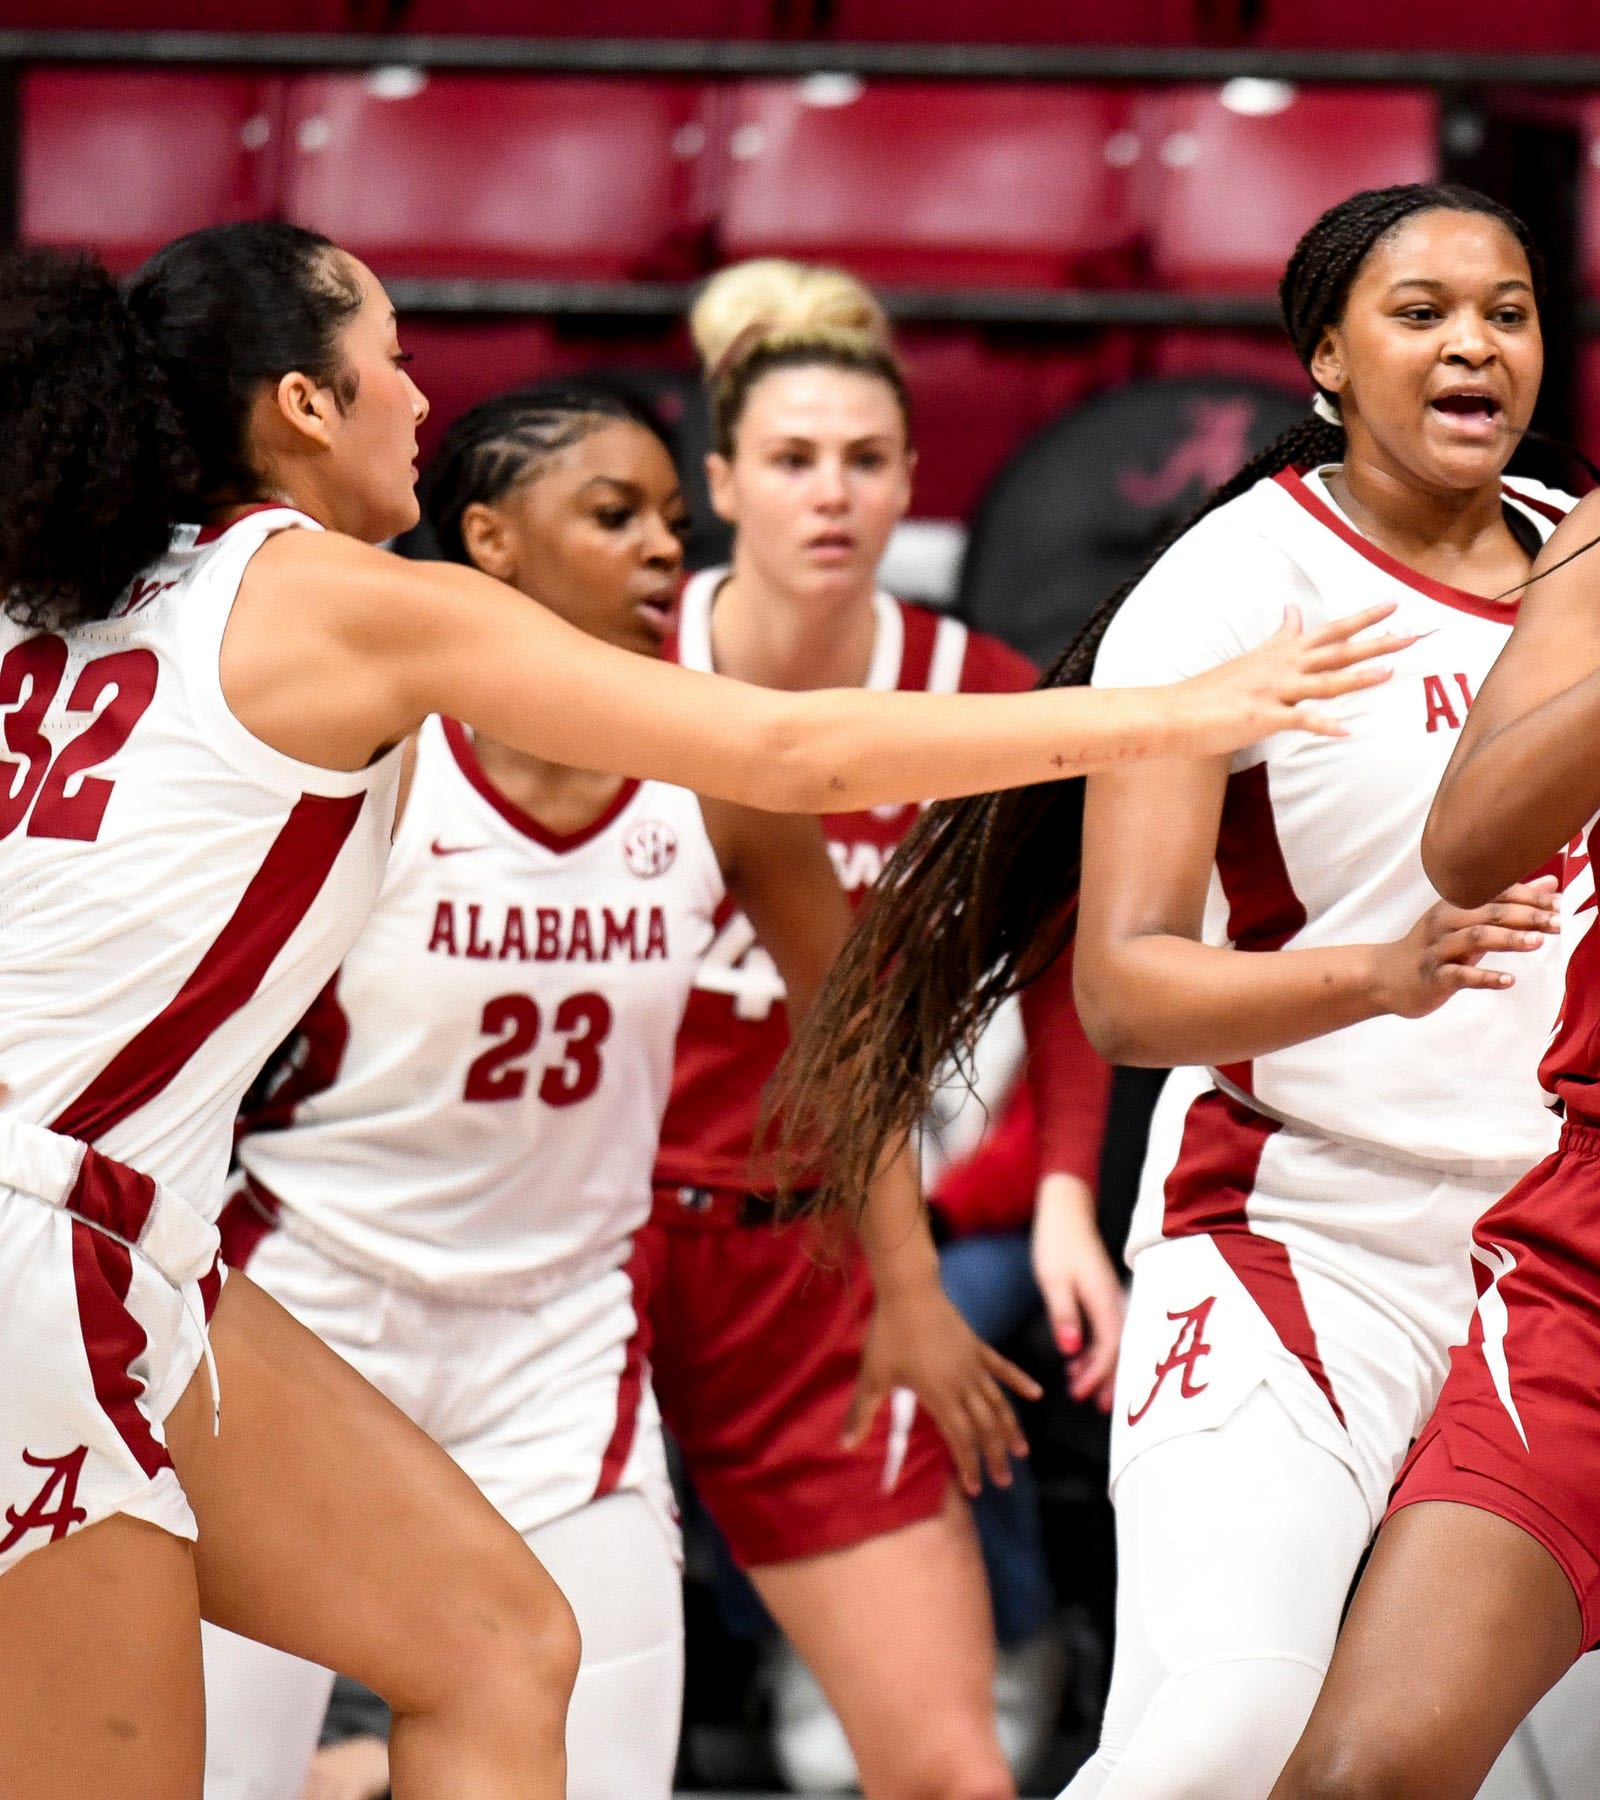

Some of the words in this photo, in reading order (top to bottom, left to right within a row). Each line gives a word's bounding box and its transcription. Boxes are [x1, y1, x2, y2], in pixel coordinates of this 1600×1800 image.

[0, 631, 159, 842] 32
[427, 900, 670, 963] ALABAMA
[462, 991, 613, 1107] 23
